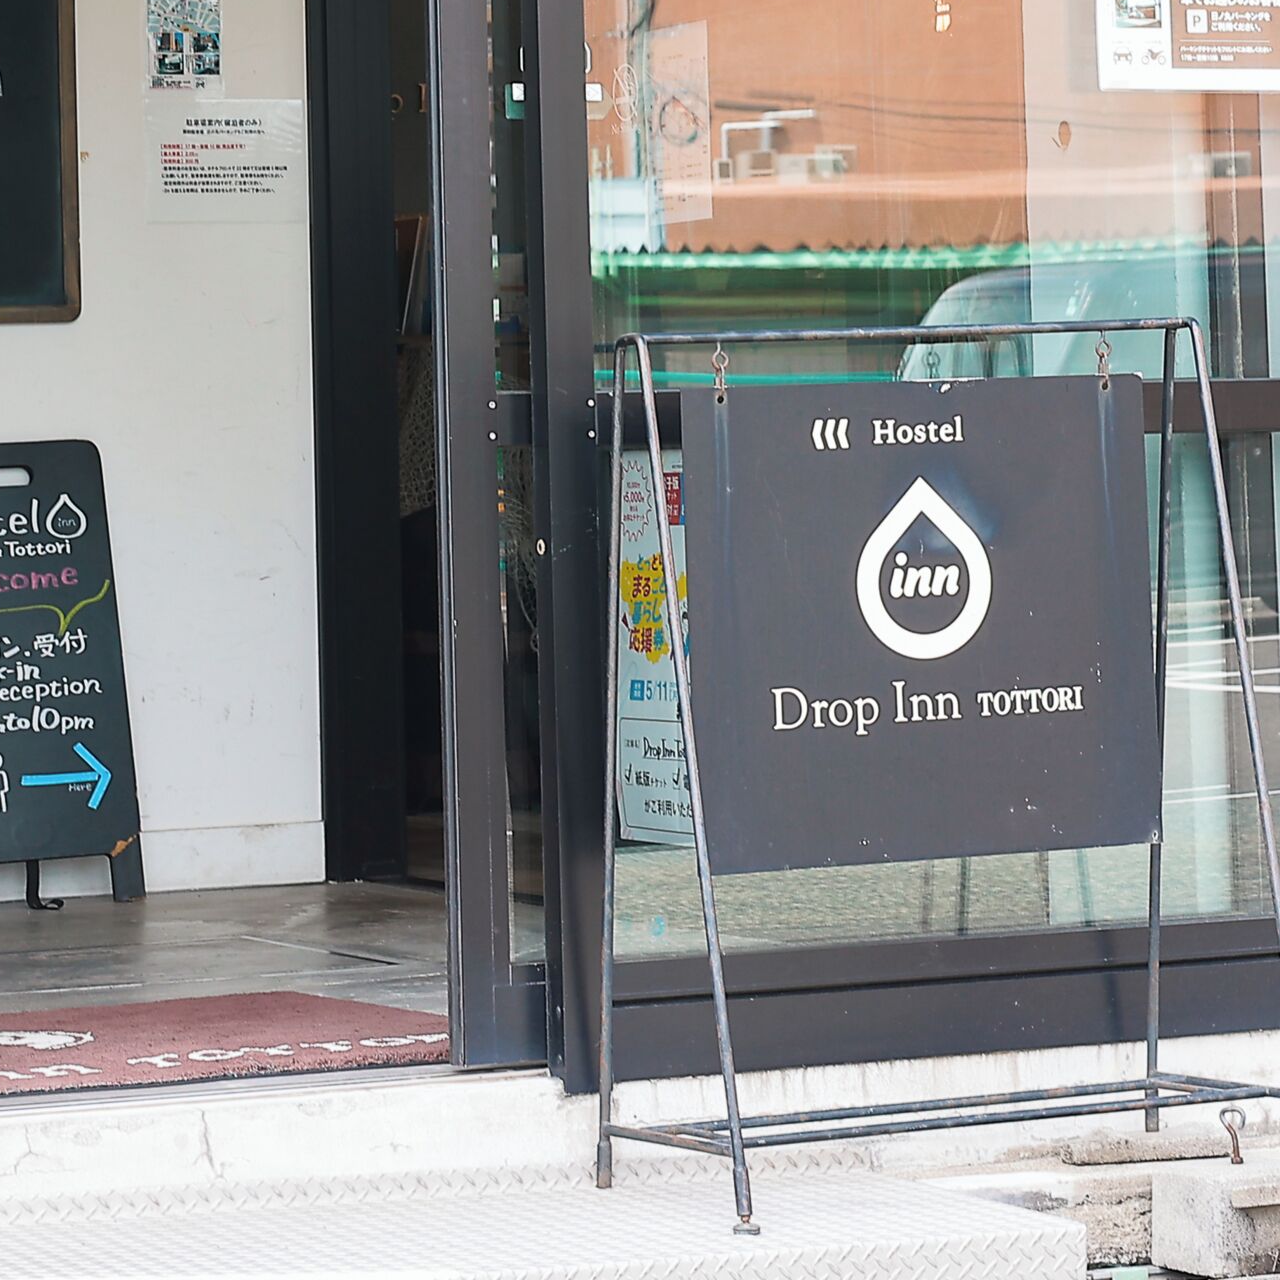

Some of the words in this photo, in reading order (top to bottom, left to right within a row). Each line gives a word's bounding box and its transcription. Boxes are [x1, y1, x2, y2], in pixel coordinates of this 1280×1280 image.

[871, 414, 964, 446] Hostel
[4, 539, 72, 558] Tottori
[889, 551, 961, 599] inn
[770, 685, 880, 736] Drop
[891, 680, 963, 724] Inn
[976, 686, 1084, 717] TOTTORI
